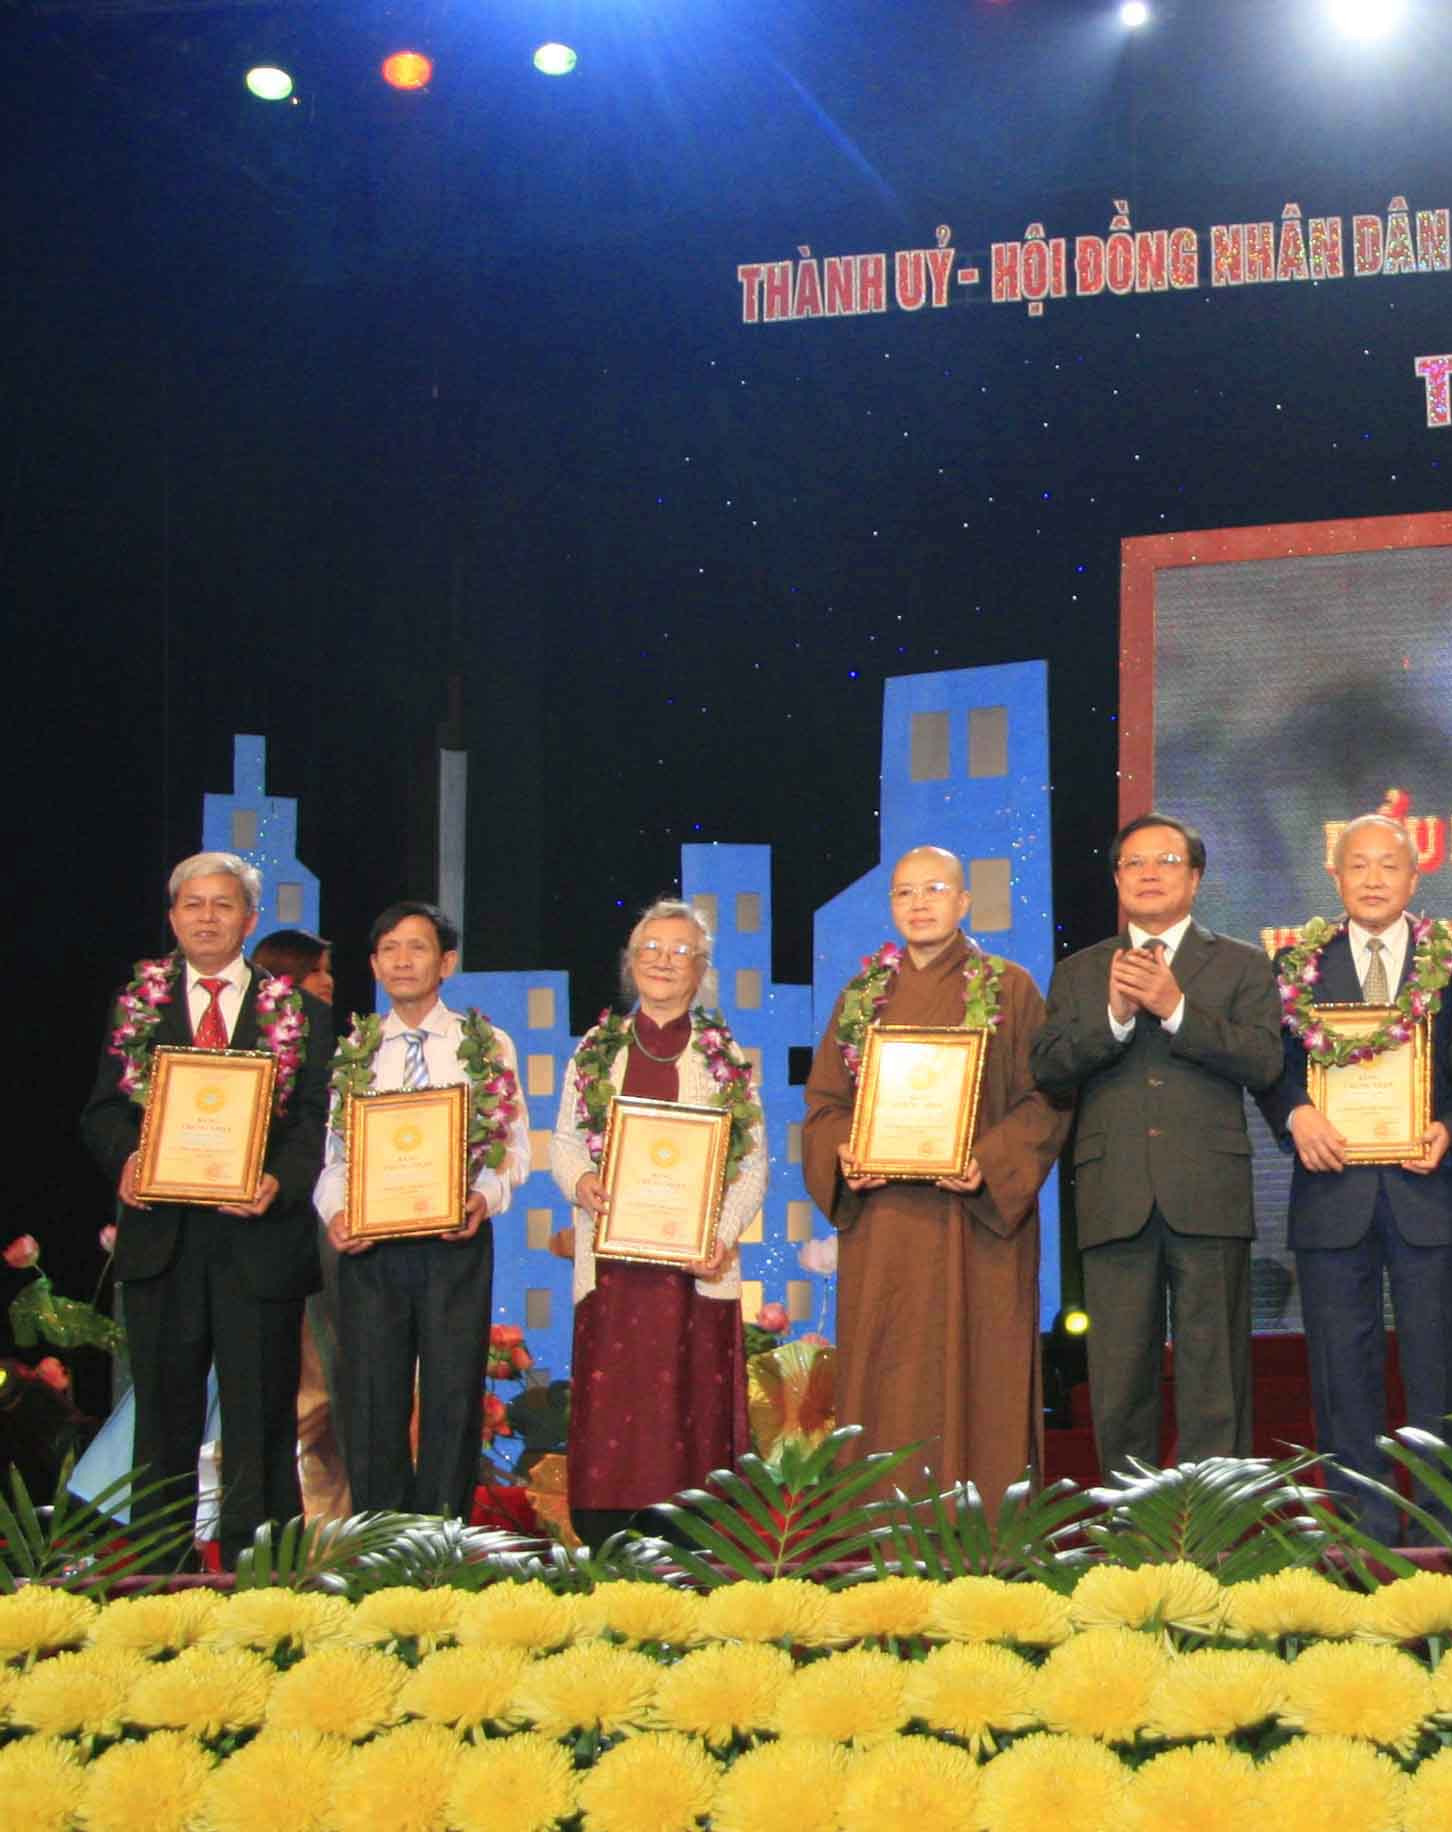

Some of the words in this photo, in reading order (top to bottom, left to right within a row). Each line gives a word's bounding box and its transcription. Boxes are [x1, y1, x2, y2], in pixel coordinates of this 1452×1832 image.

[737, 245, 888, 323] THÀNH
[991, 222, 1066, 316] HỘI
[1075, 200, 1199, 296] ĐỒNG
[1210, 203, 1344, 287] NHÂN
